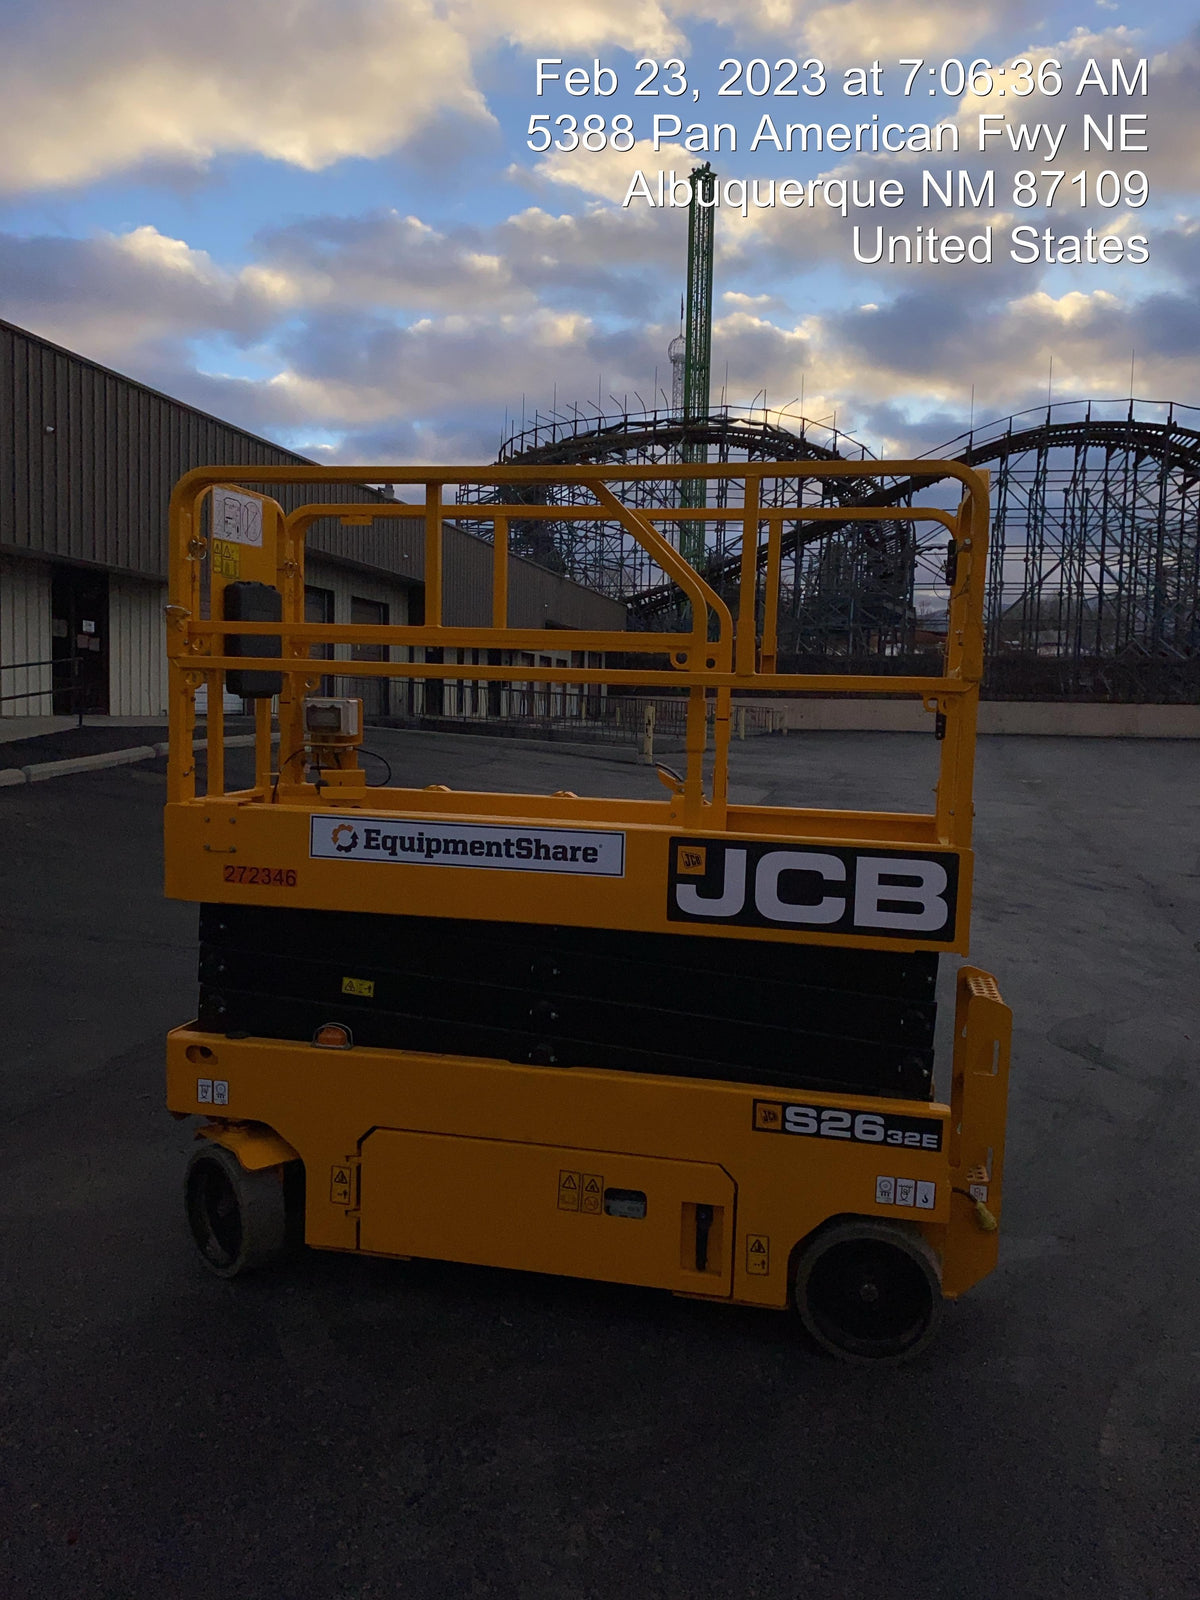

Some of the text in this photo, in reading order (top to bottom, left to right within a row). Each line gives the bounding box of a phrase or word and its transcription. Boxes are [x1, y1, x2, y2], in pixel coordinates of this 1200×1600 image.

[364, 828, 599, 864] EquipmentShare
[223, 865, 297, 887] 272346
[675, 847, 949, 932] JCB
